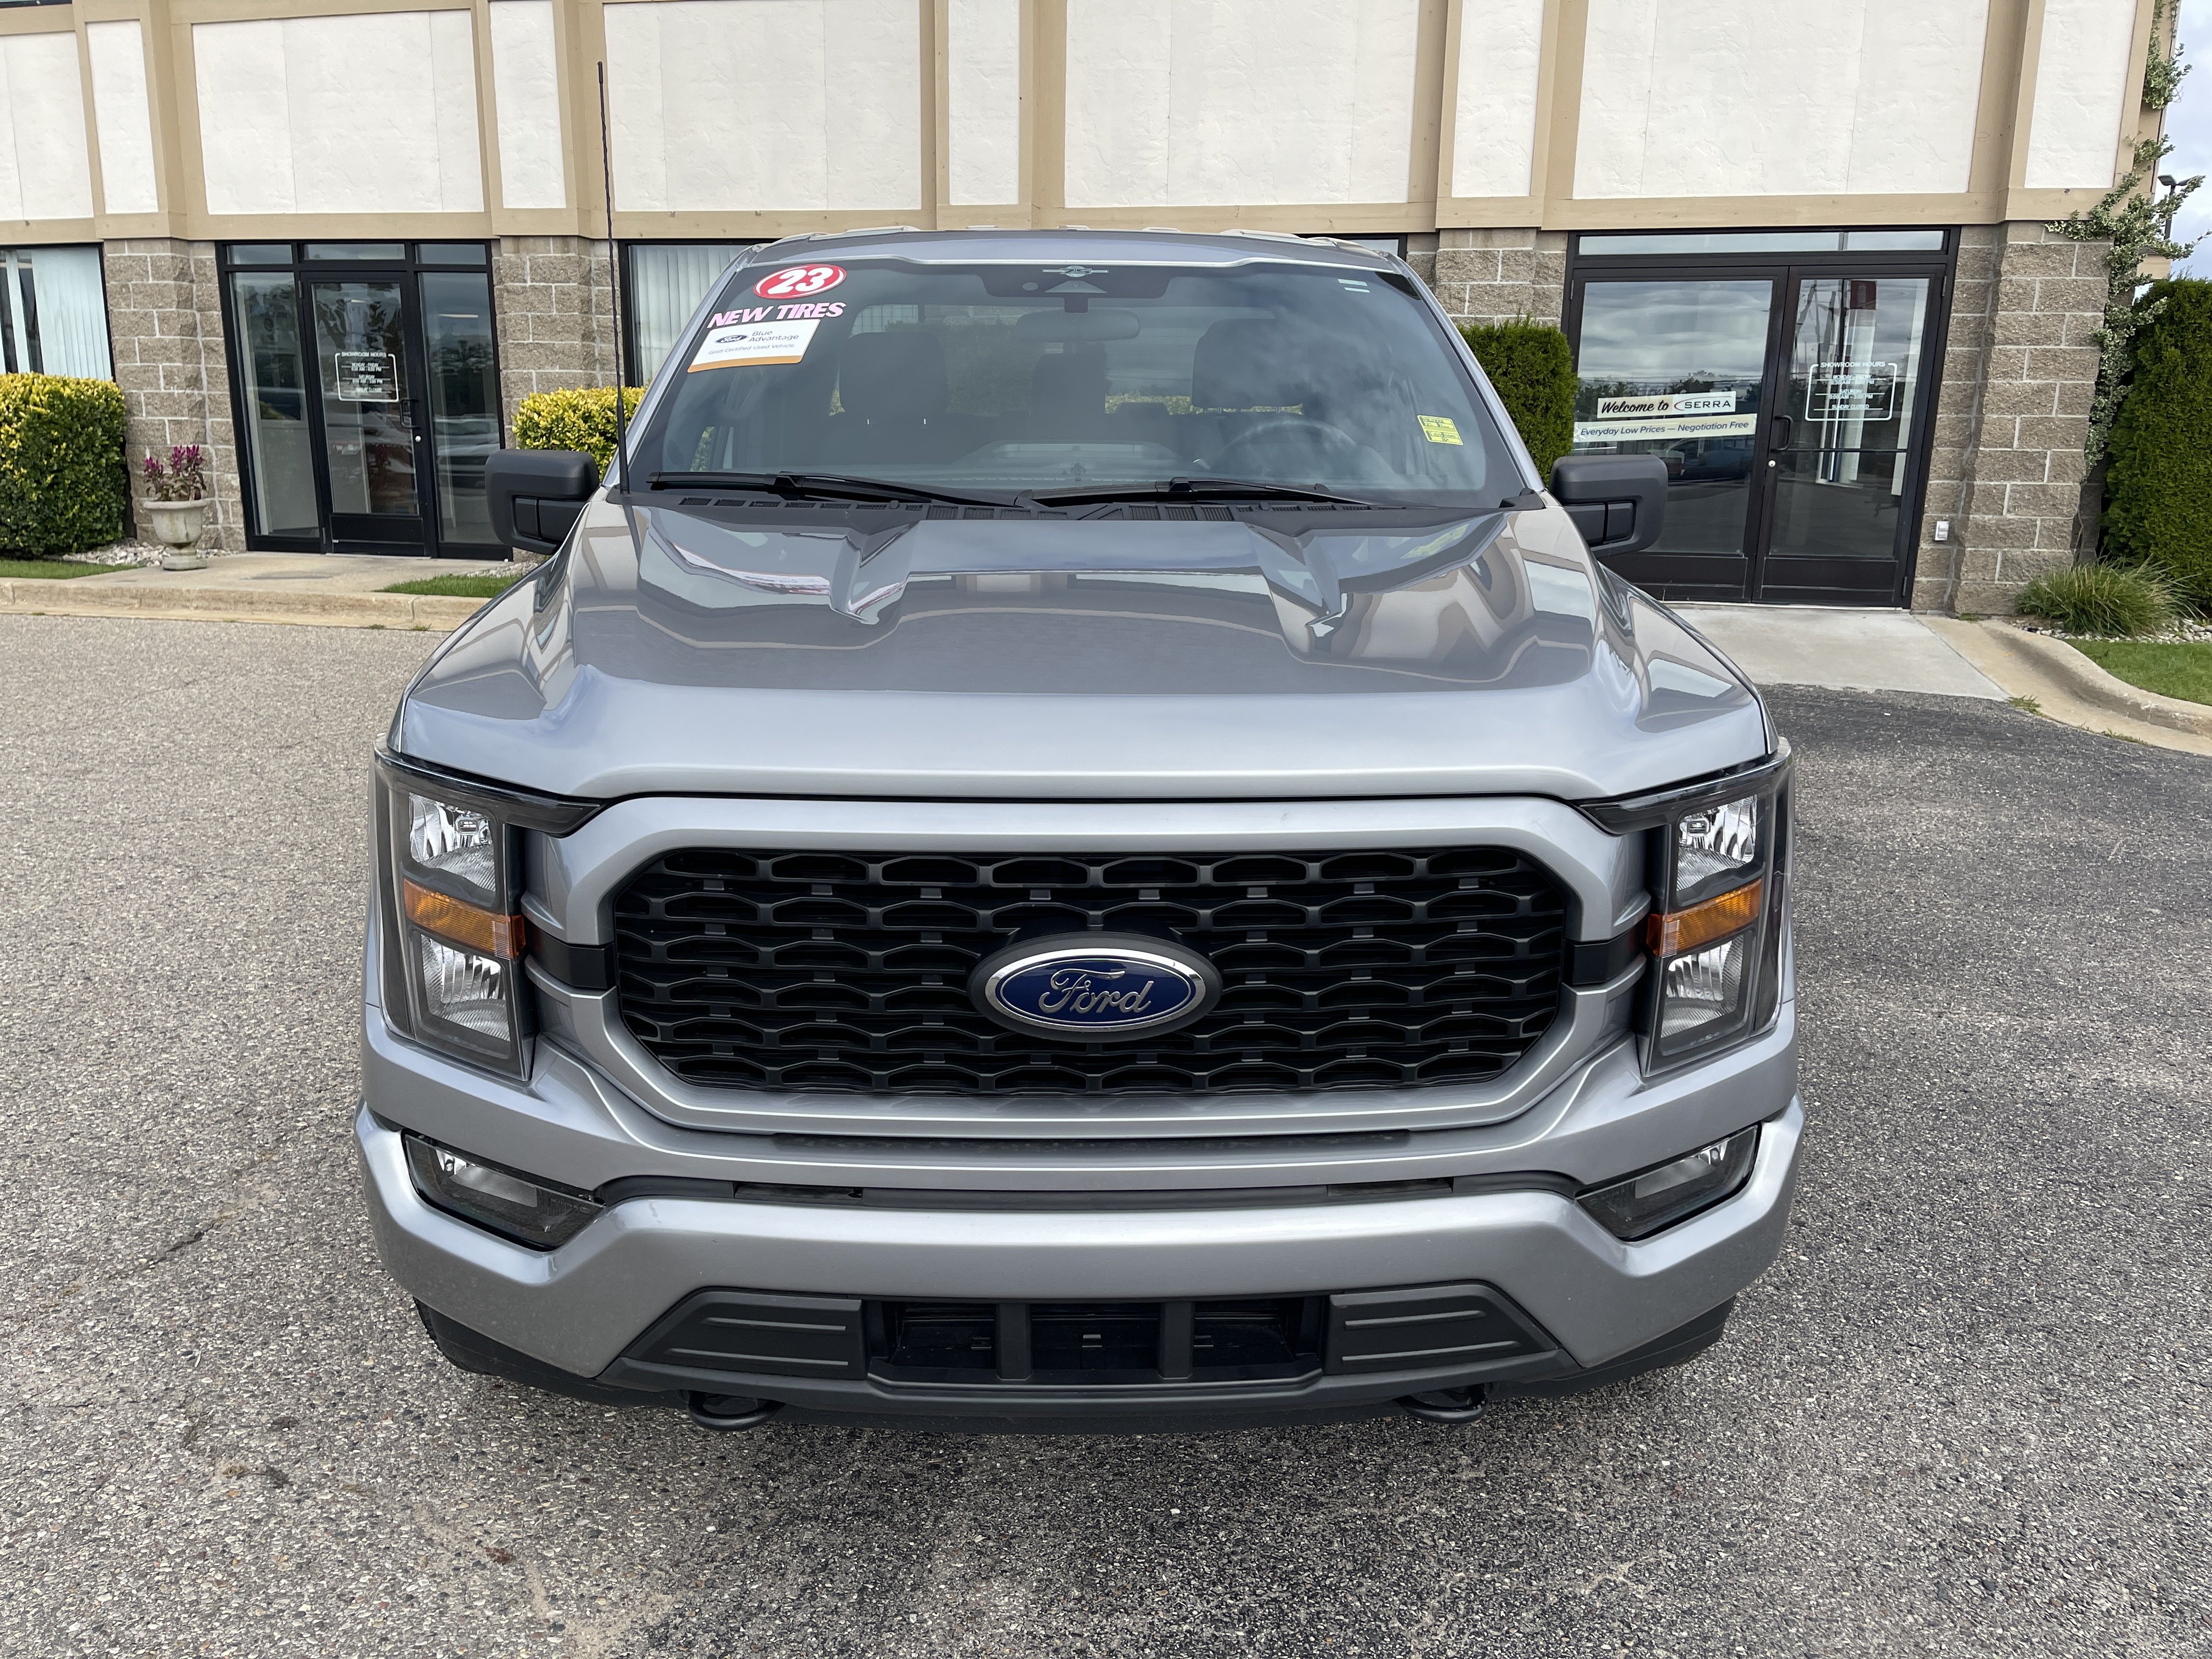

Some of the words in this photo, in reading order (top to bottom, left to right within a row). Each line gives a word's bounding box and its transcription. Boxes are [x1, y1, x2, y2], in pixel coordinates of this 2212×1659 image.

[768, 267, 834, 294] 23
[707, 306, 774, 329] NEW
[776, 302, 847, 320] TIRES
[748, 334, 799, 342] Advantage
[1601, 400, 1655, 414] Welcome
[1657, 399, 1669, 411] to
[1684, 400, 1731, 409] SERRA
[1581, 427, 1619, 436] Everyday
[1678, 422, 1728, 432] Negotiation
[1039, 968, 1154, 1014] Ford
